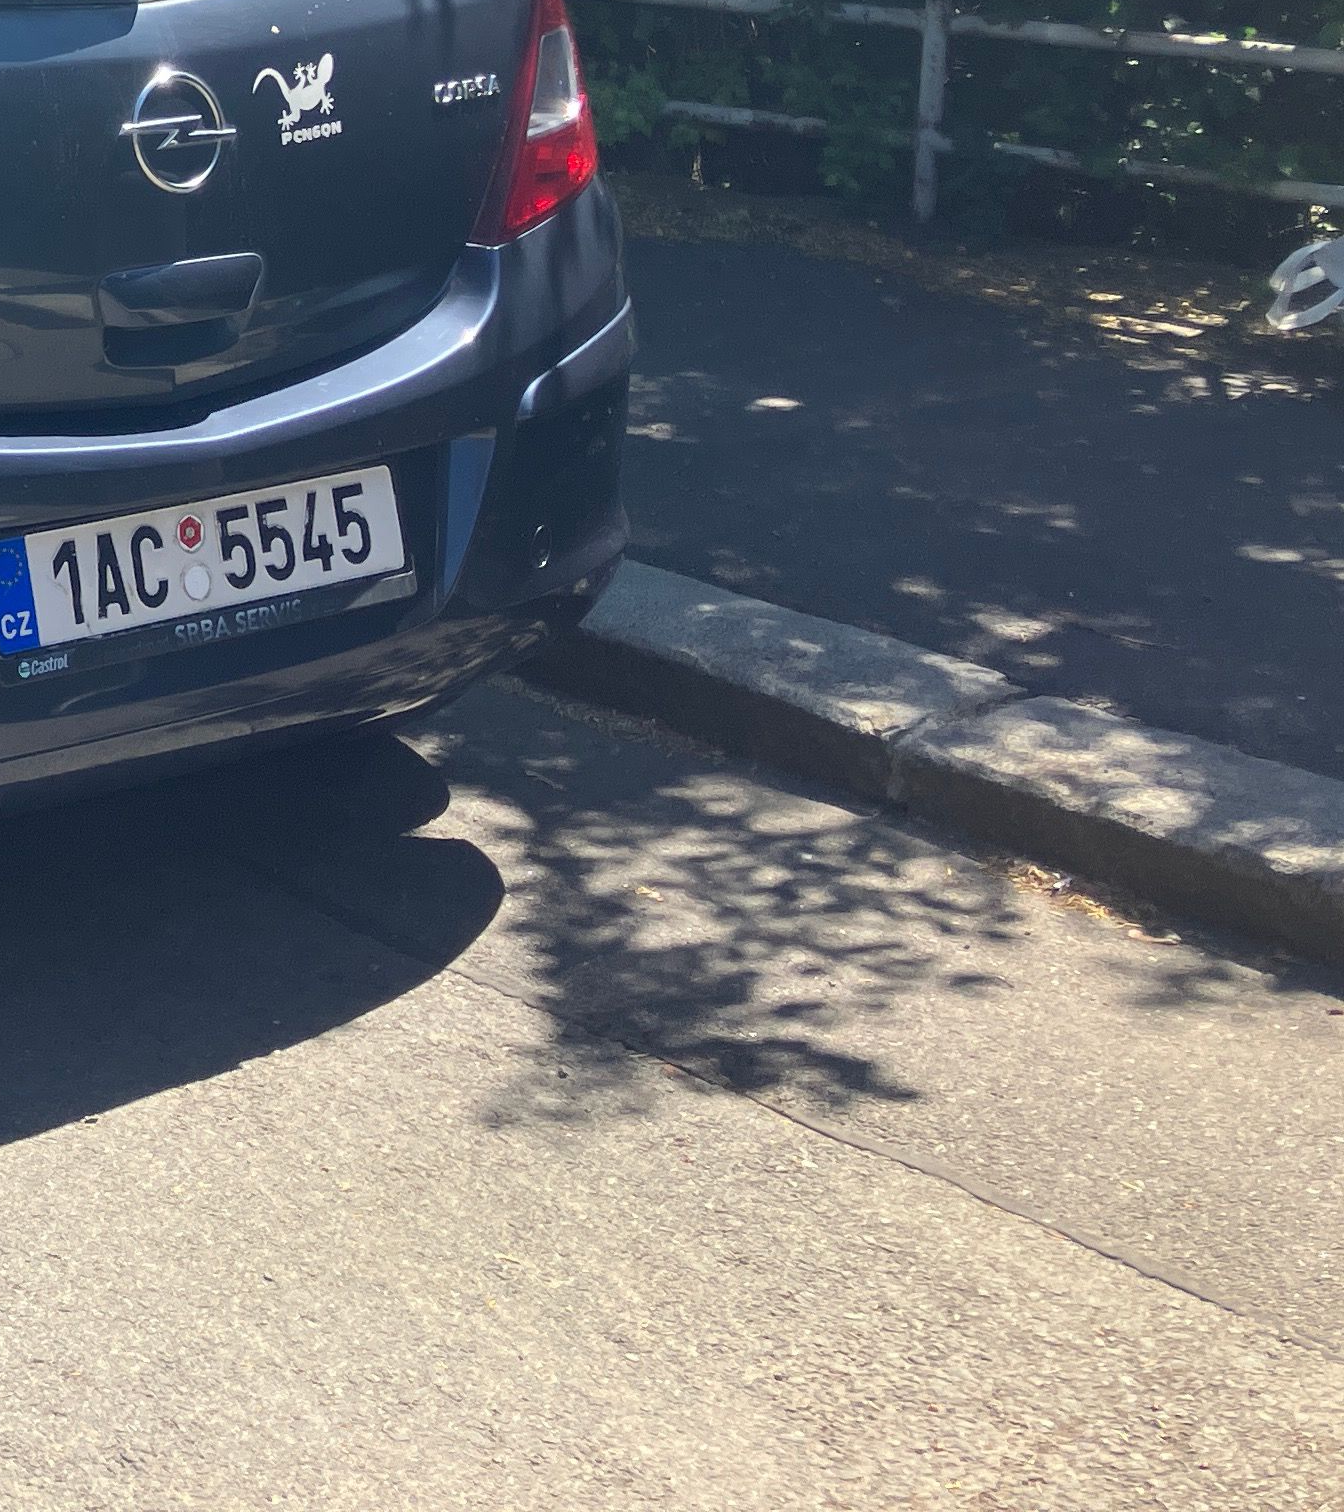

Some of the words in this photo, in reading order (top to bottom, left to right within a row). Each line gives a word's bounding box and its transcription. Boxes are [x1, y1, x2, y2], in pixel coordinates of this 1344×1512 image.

[52, 524, 170, 626] 1AC
[216, 482, 372, 590] 5545
[0, 609, 33, 640] CZ
[174, 614, 233, 646] SRBA
[31, 653, 69, 677] Castrol
